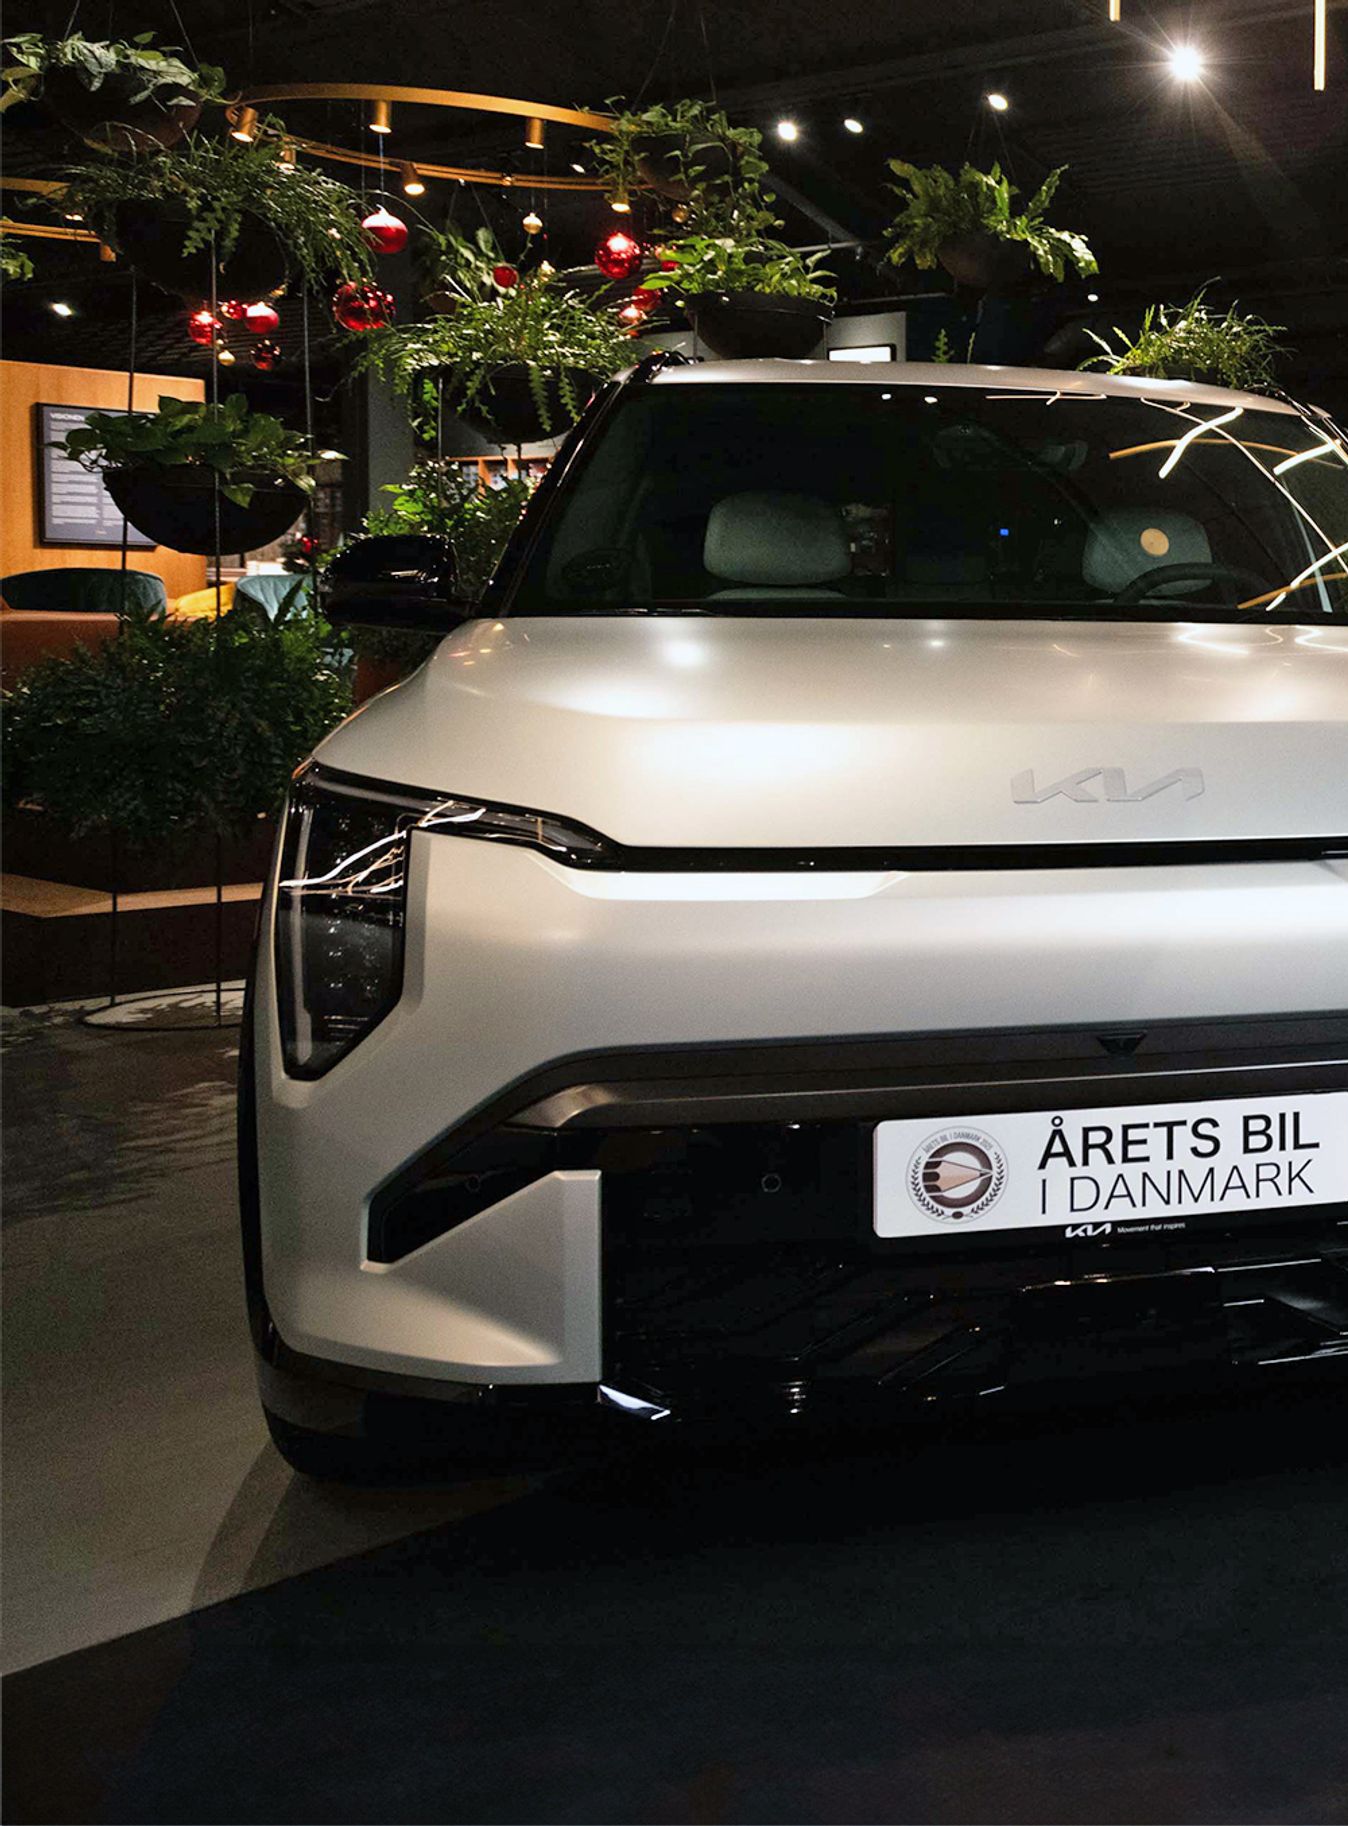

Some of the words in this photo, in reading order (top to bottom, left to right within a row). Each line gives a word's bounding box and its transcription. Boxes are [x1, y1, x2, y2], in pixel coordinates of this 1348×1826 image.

[1037, 1115, 1222, 1170] ÅRETS
[1241, 1110, 1320, 1155] BIL
[1041, 1178, 1047, 1215] I
[1069, 1158, 1315, 1213] DANMARK
[1117, 1225, 1149, 1234] Movement
[1163, 1222, 1186, 1230] inspires
